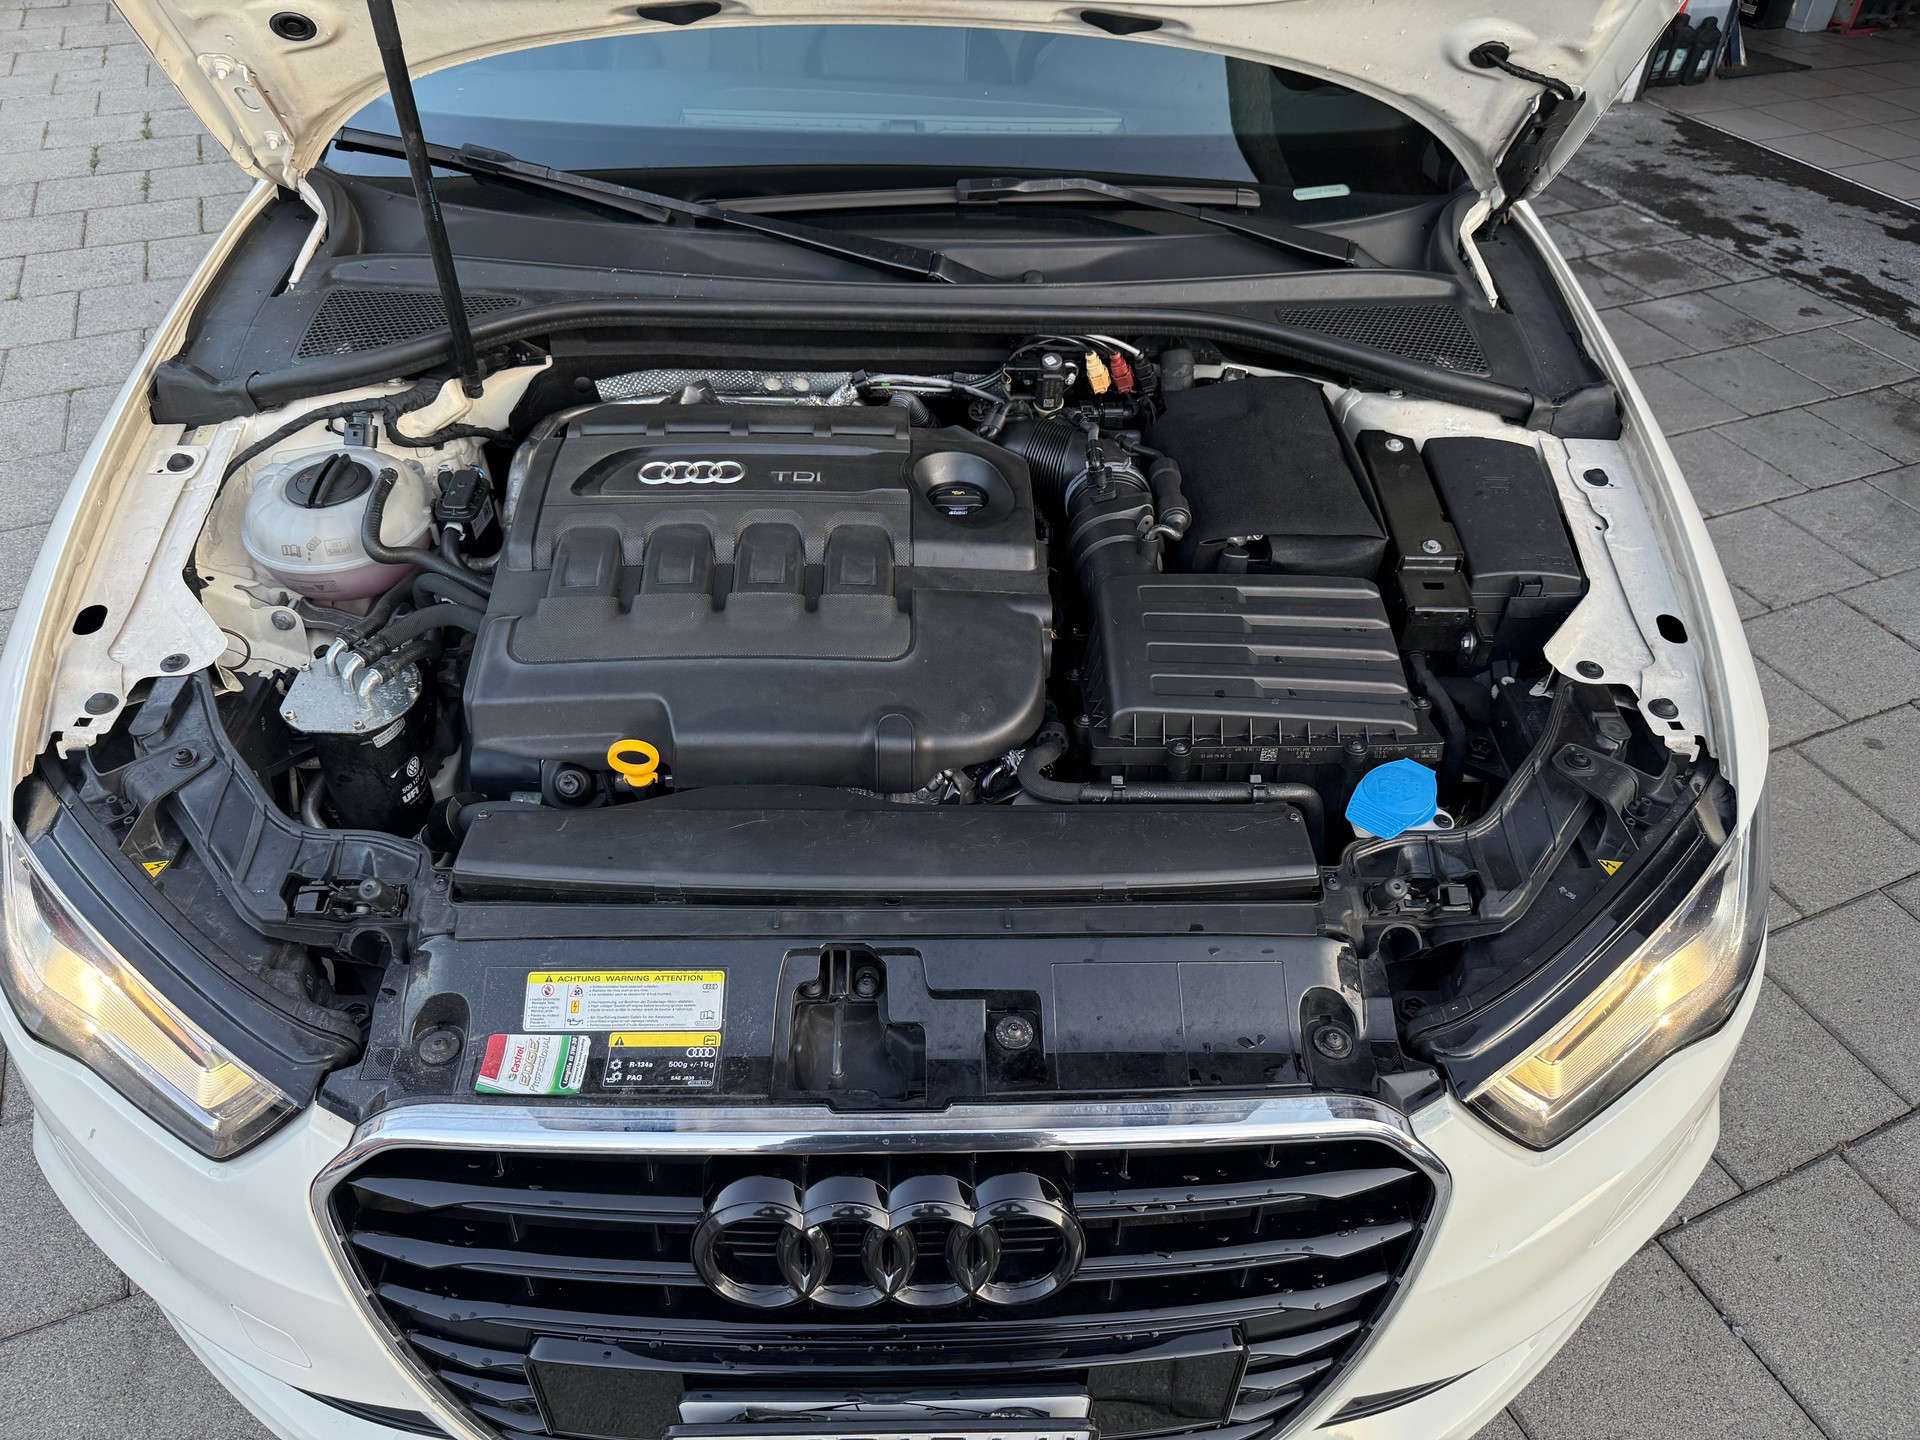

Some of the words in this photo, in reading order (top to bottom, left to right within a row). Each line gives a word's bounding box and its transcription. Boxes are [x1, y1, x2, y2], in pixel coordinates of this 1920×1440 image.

[771, 471, 822, 482] TDI
[402, 786, 419, 803] UFI
[557, 975, 601, 983] ACHTUNG
[655, 974, 704, 982] ATTENTION
[570, 1037, 578, 1055] 5W-30
[511, 1045, 524, 1074] Castrol
[519, 1038, 541, 1087] EDGE
[668, 1061, 688, 1069] 500g
